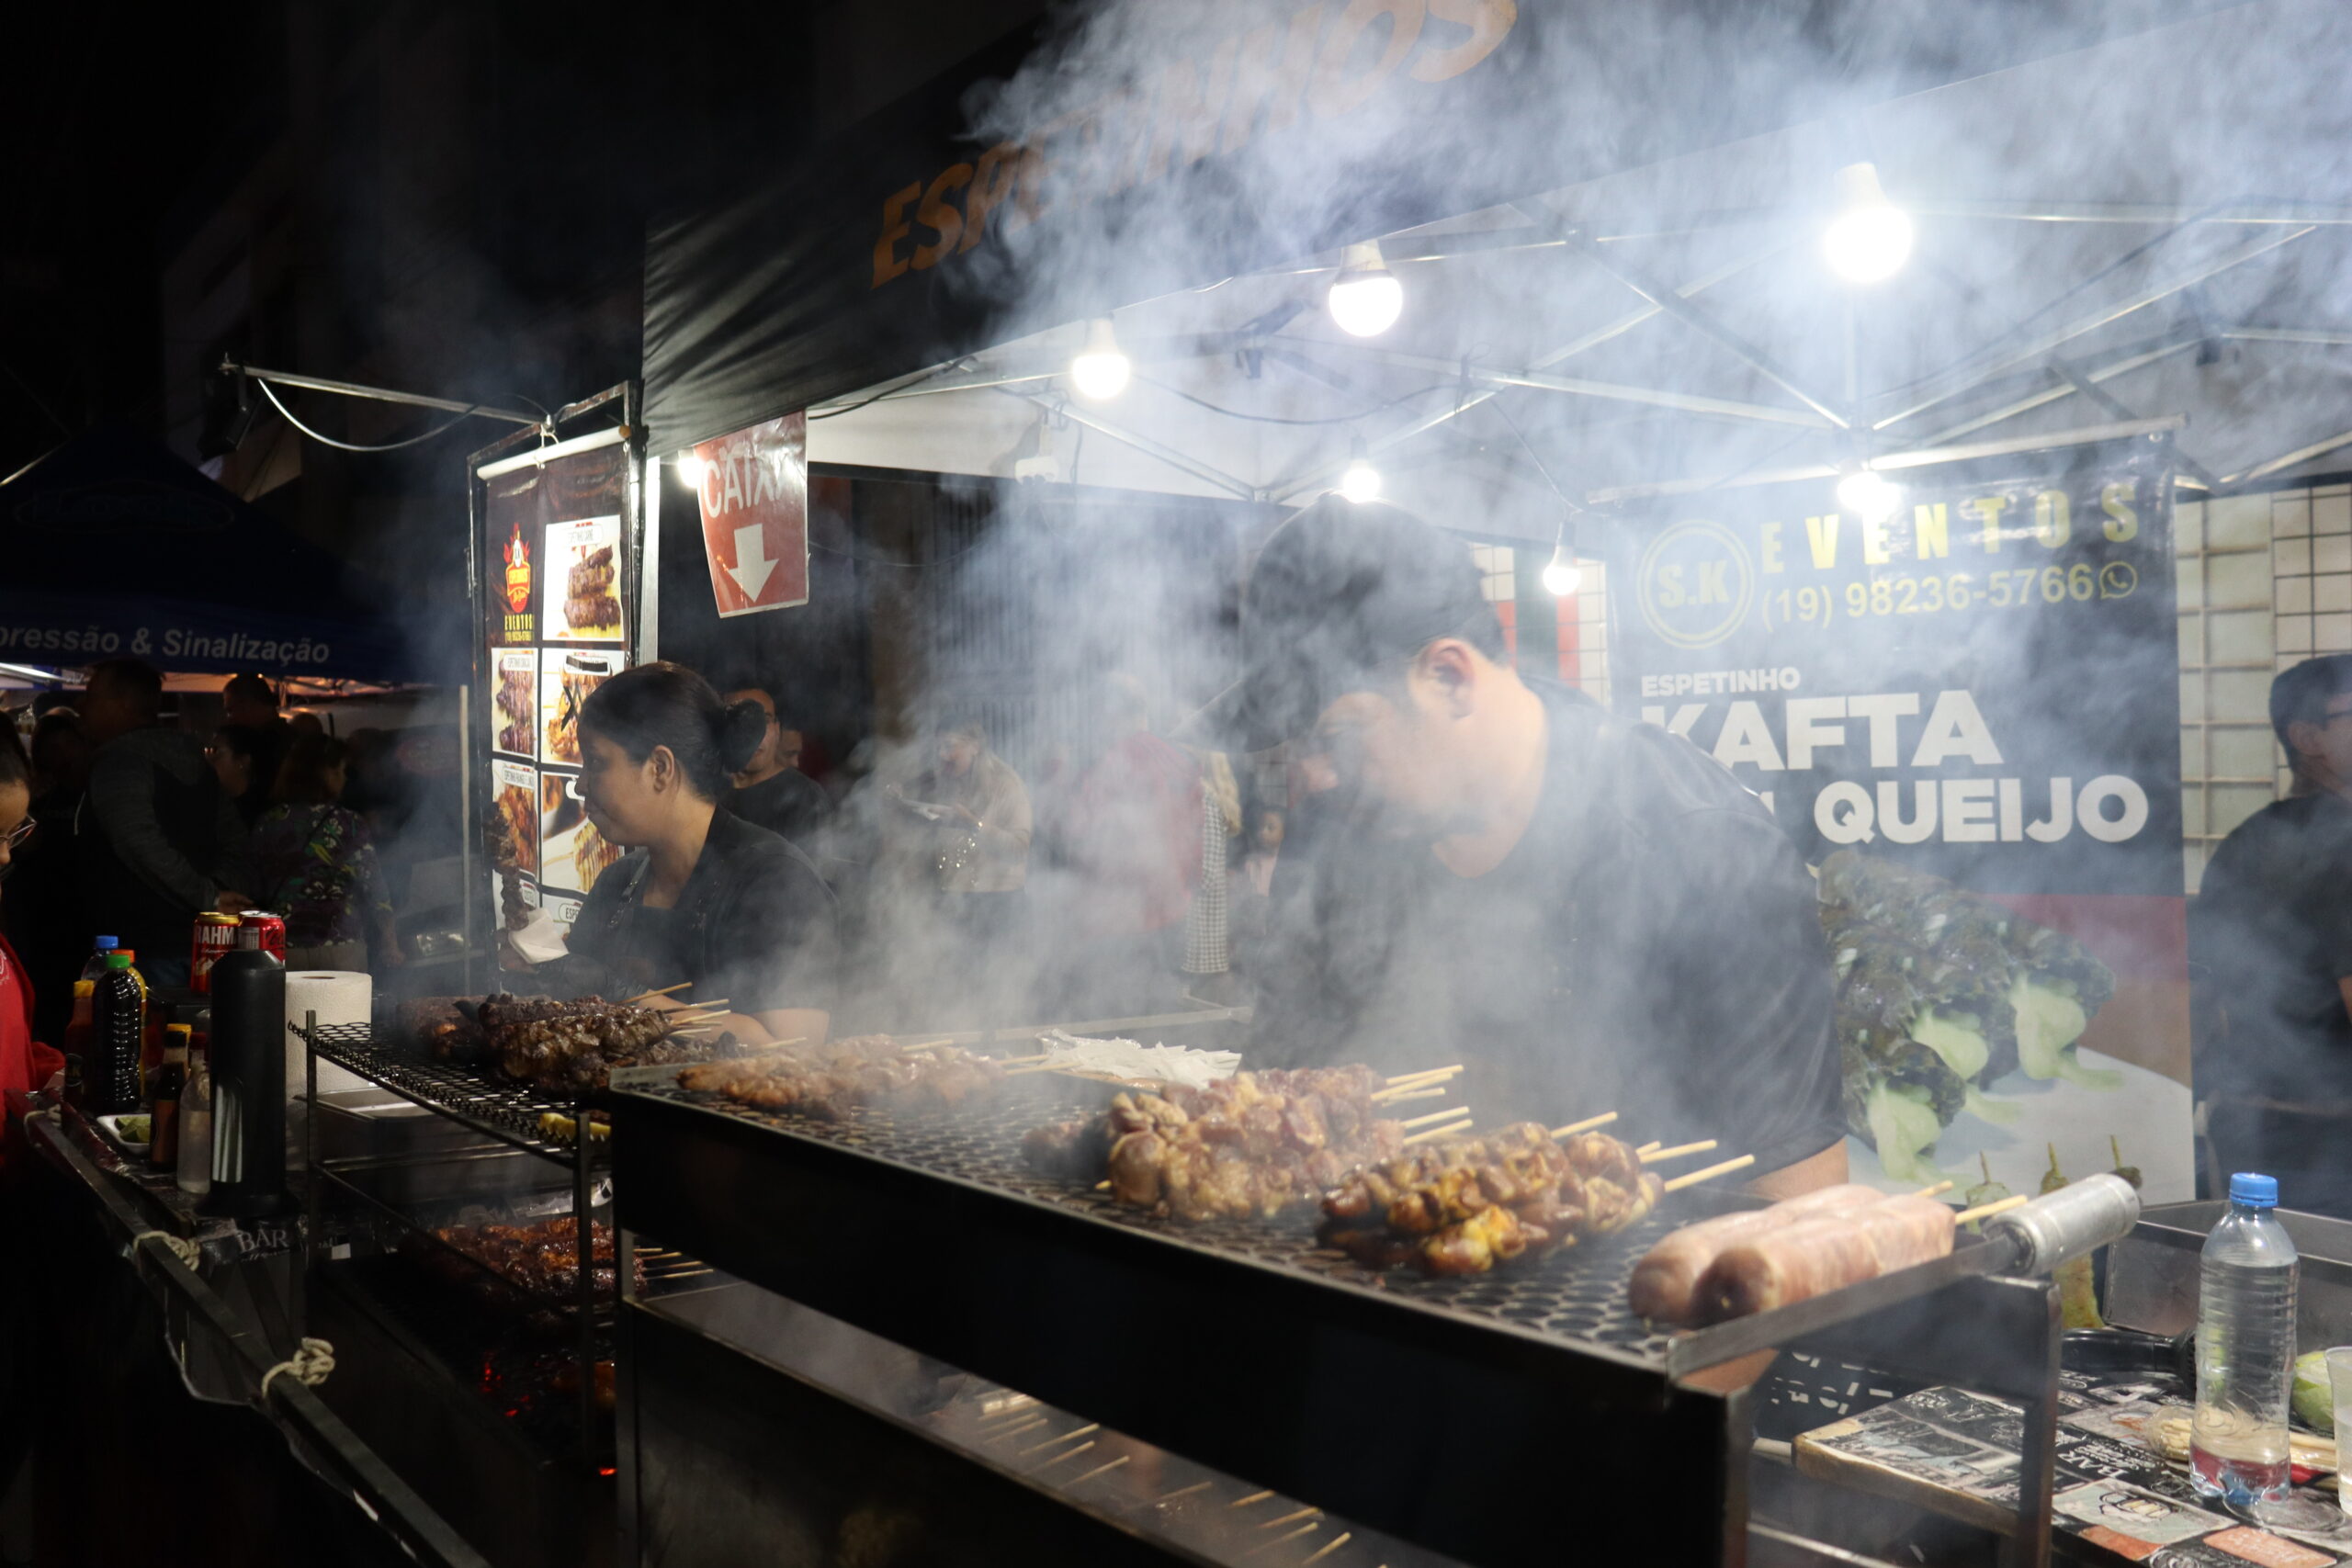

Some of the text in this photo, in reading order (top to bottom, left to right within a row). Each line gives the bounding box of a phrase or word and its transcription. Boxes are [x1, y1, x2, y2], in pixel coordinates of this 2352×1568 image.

[1759, 484, 2139, 574] EVENTOS
[1657, 558, 1729, 608] S.K
[1762, 563, 2095, 633] (19) 98236-5766
[130, 626, 153, 655] &
[163, 628, 330, 666] Sinalização
[1641, 666, 1801, 698] ESPETINHO
[1814, 774, 2149, 845] QUEIJO
[235, 1228, 289, 1255] BAR
